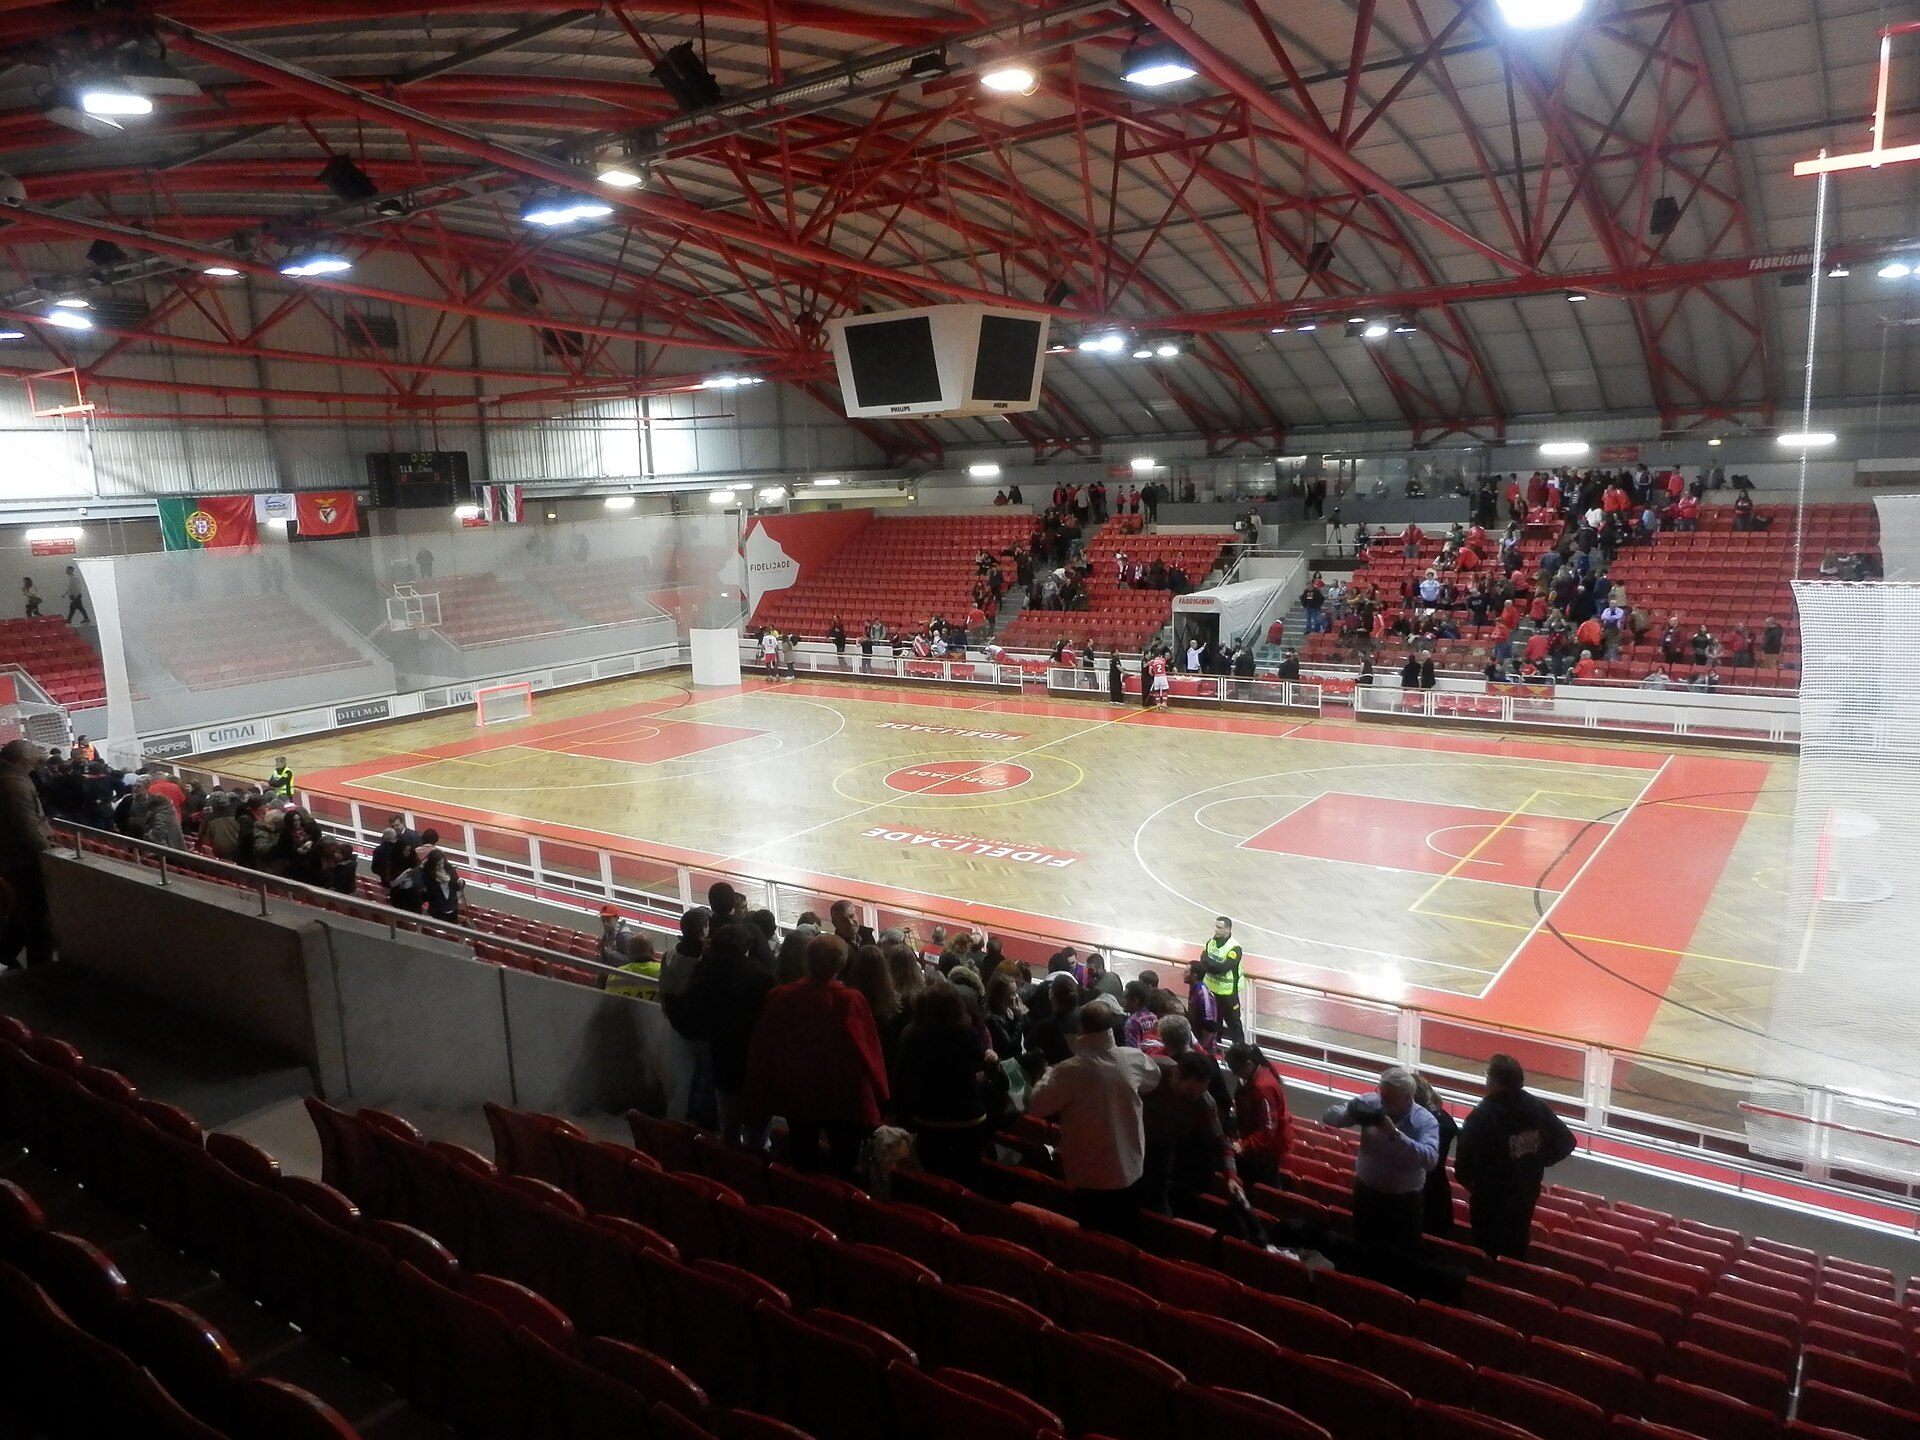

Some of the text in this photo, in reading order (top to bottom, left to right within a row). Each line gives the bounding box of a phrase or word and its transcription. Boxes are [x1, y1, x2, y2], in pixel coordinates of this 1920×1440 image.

[890, 405, 911, 413] PHILIPS
[750, 560, 790, 572] FIDELIDADE
[337, 705, 388, 721] DIELMAR
[875, 722, 1024, 742] FIDELIDADE
[906, 769, 1009, 787] FIDELDADE
[860, 827, 1078, 868] FIDELIDADE
